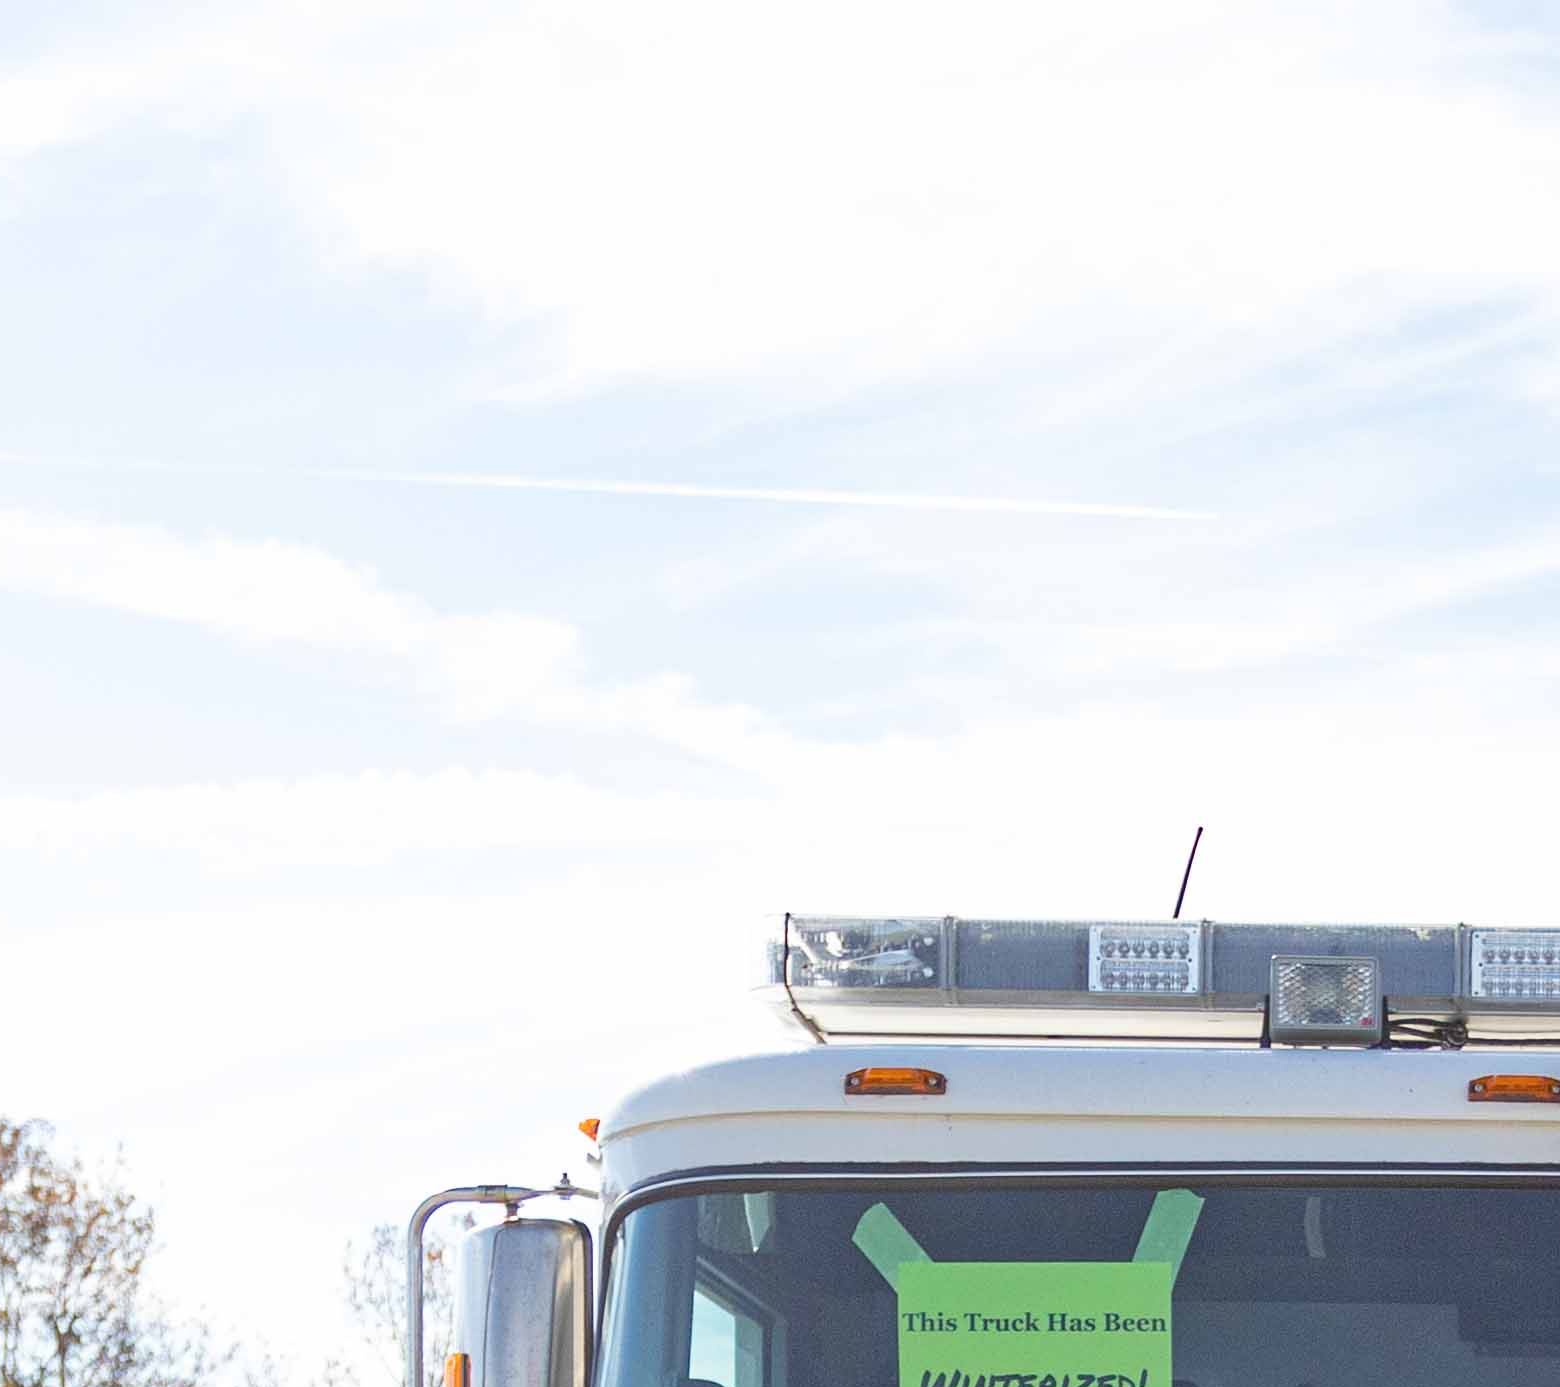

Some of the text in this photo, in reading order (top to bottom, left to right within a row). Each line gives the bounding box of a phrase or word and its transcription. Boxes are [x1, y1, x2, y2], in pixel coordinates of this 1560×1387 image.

[902, 1312, 1167, 1332] This Truck Has Been
